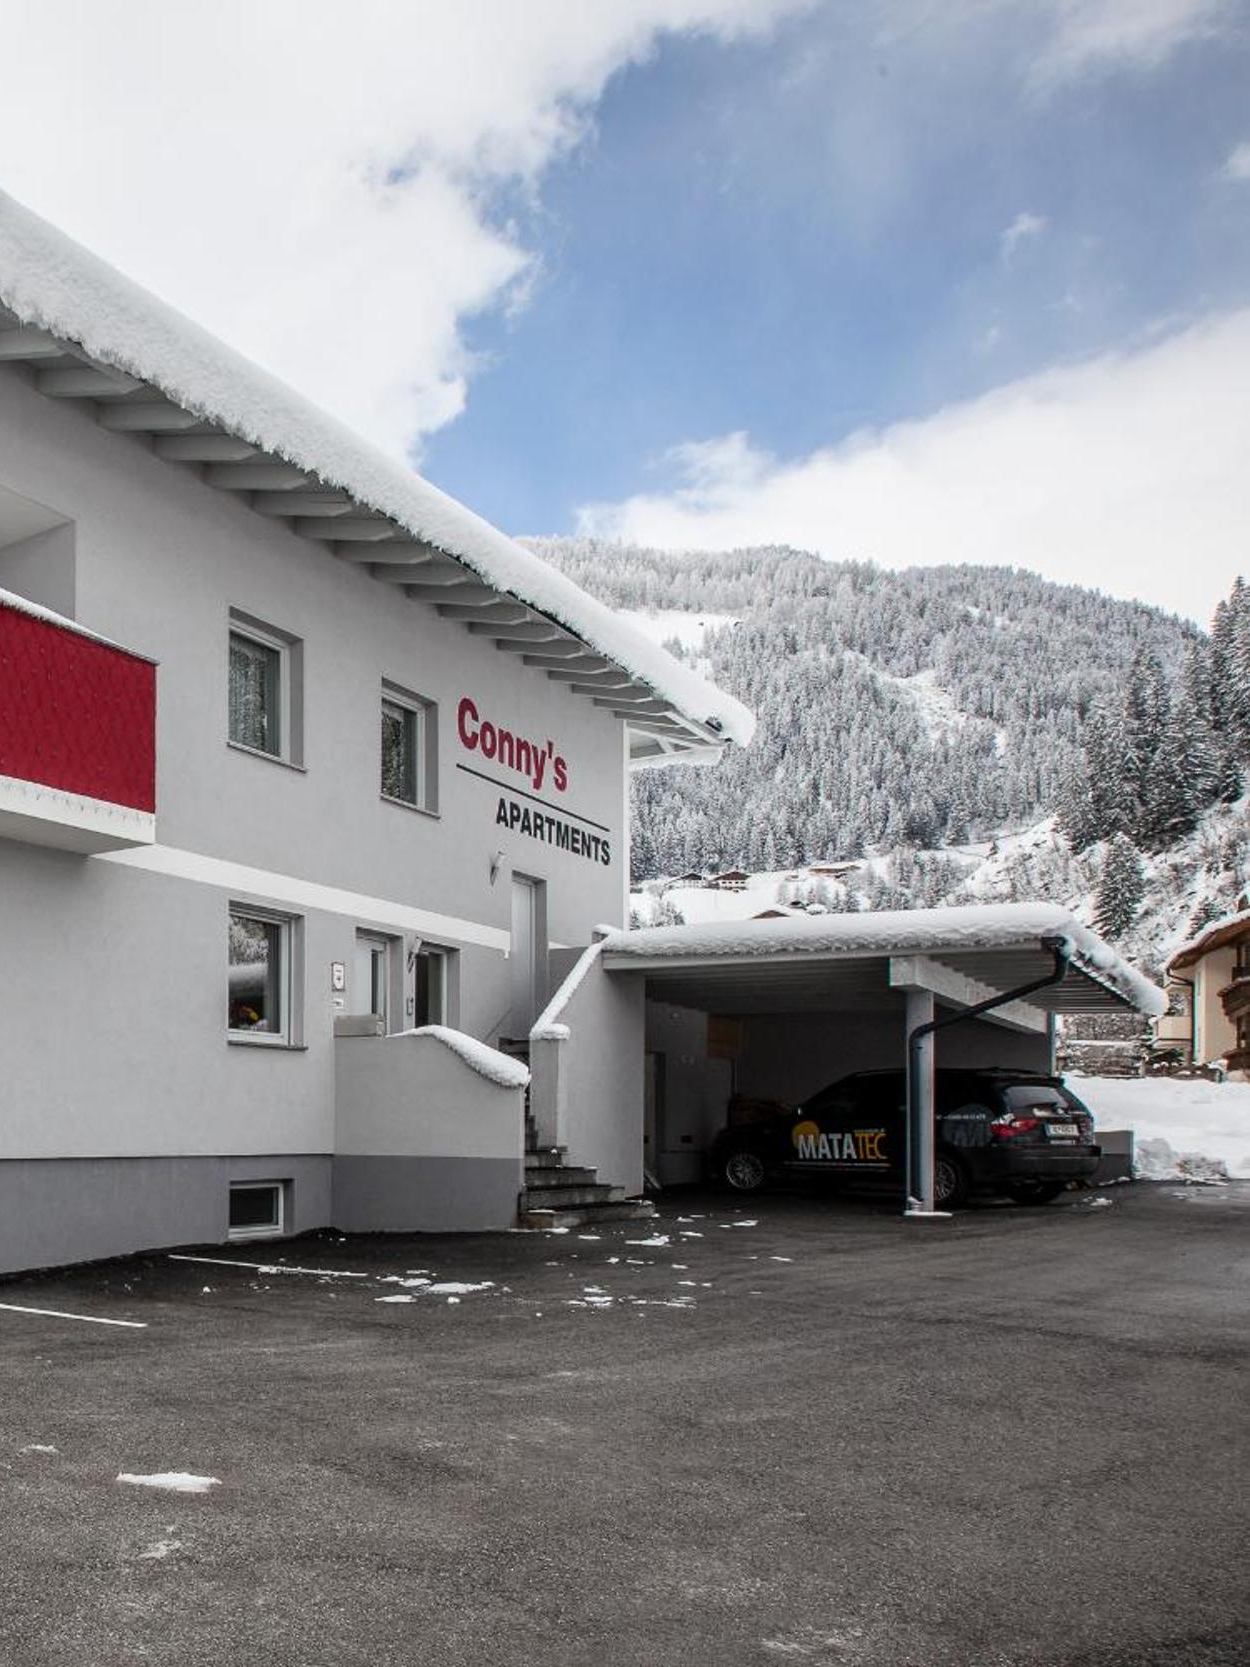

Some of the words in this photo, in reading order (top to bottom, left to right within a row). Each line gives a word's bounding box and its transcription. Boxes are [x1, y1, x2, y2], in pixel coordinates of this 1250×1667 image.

[457, 697, 567, 792] Conny's
[496, 798, 611, 866] APARTMENTS
[797, 1131, 889, 1160] MATATEC
